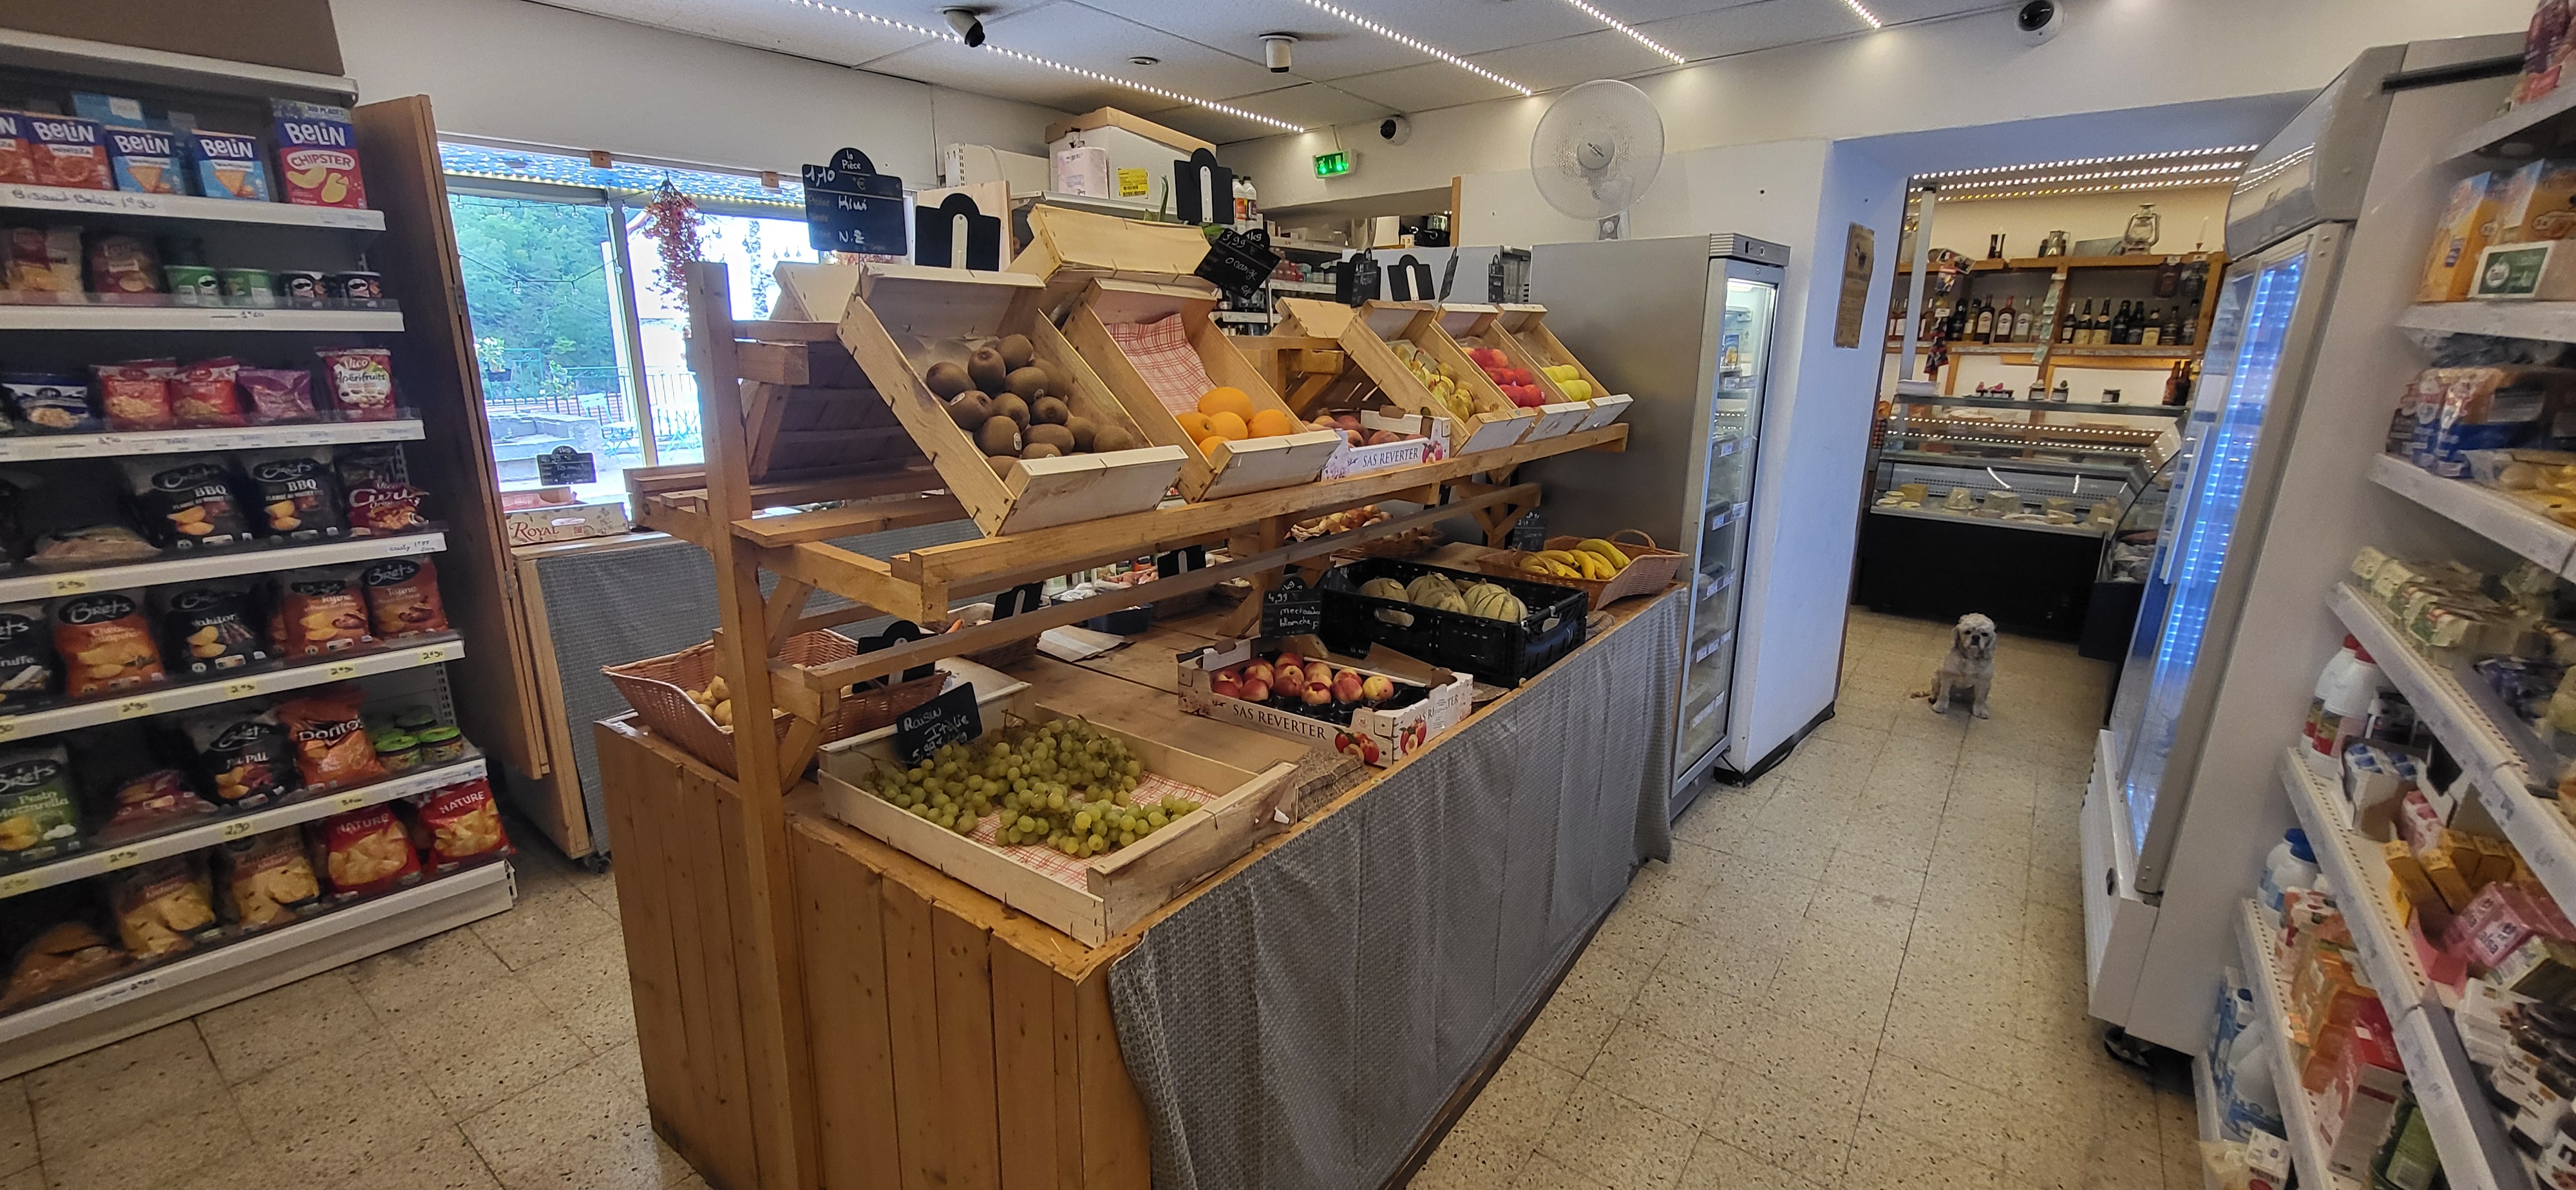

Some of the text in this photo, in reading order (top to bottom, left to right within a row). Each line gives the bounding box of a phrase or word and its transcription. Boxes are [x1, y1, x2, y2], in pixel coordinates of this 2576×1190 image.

[290, 155, 352, 167] CHIPSTER
[846, 149, 853, 160] la
[842, 158, 862, 170] Pièce
[1222, 231, 1262, 249] 3,99 1kg
[336, 370, 385, 382] Apérifruits
[1362, 447, 1419, 468] SAS REVERTER
[194, 484, 228, 497] BBQ
[287, 479, 318, 492] BBQ
[1268, 592, 1288, 604] 4,99
[904, 707, 942, 732] Raisin
[1233, 704, 1327, 741] SAS REVERTER
[924, 714, 969, 741] Italie
[439, 791, 486, 814] NATURE
[337, 813, 390, 833] NATURE
